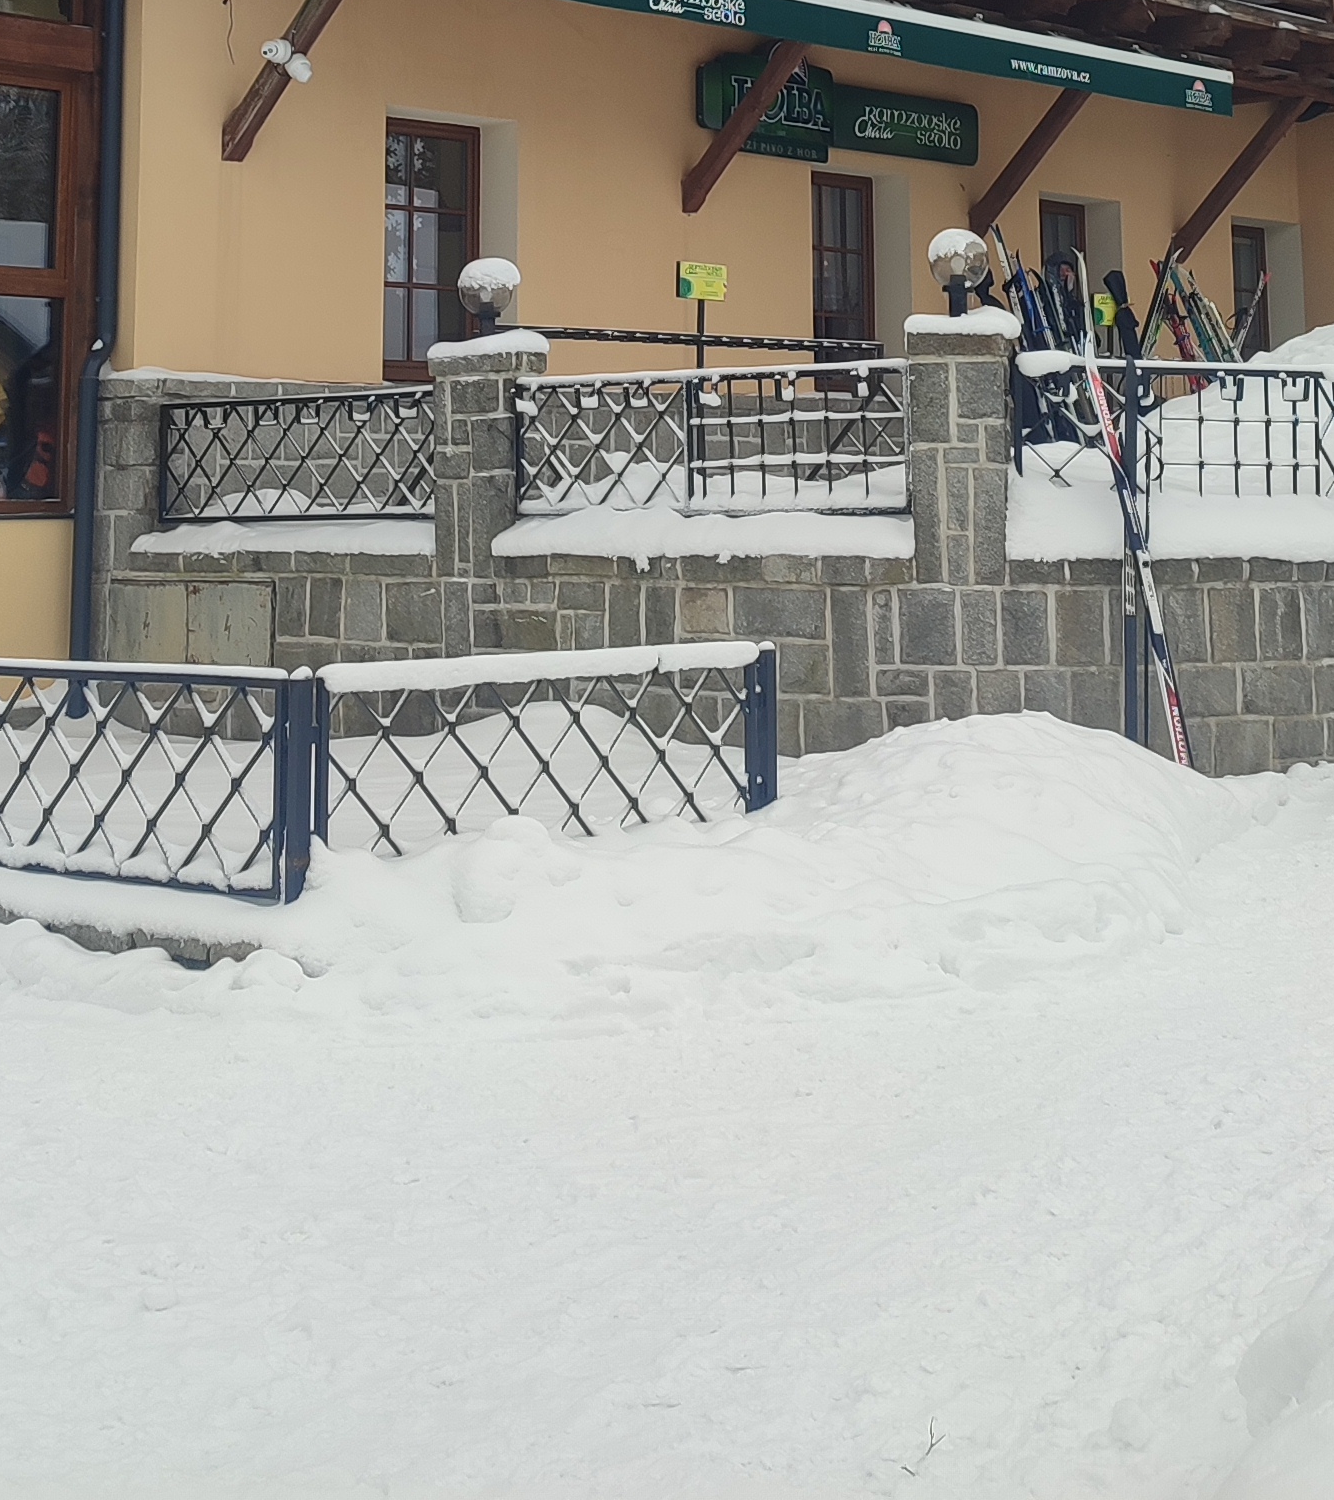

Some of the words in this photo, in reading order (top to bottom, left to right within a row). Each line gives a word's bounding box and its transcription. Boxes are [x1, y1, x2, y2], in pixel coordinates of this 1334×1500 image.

[1010, 59, 1091, 83] www.ramzova.cz
[854, 117, 895, 139] Chata
[865, 106, 961, 134] Ramzovské
[760, 142, 784, 154] PIVO
[787, 146, 793, 156] Z
[797, 148, 818, 159] HOR
[1096, 387, 1115, 434] ATOMIC
